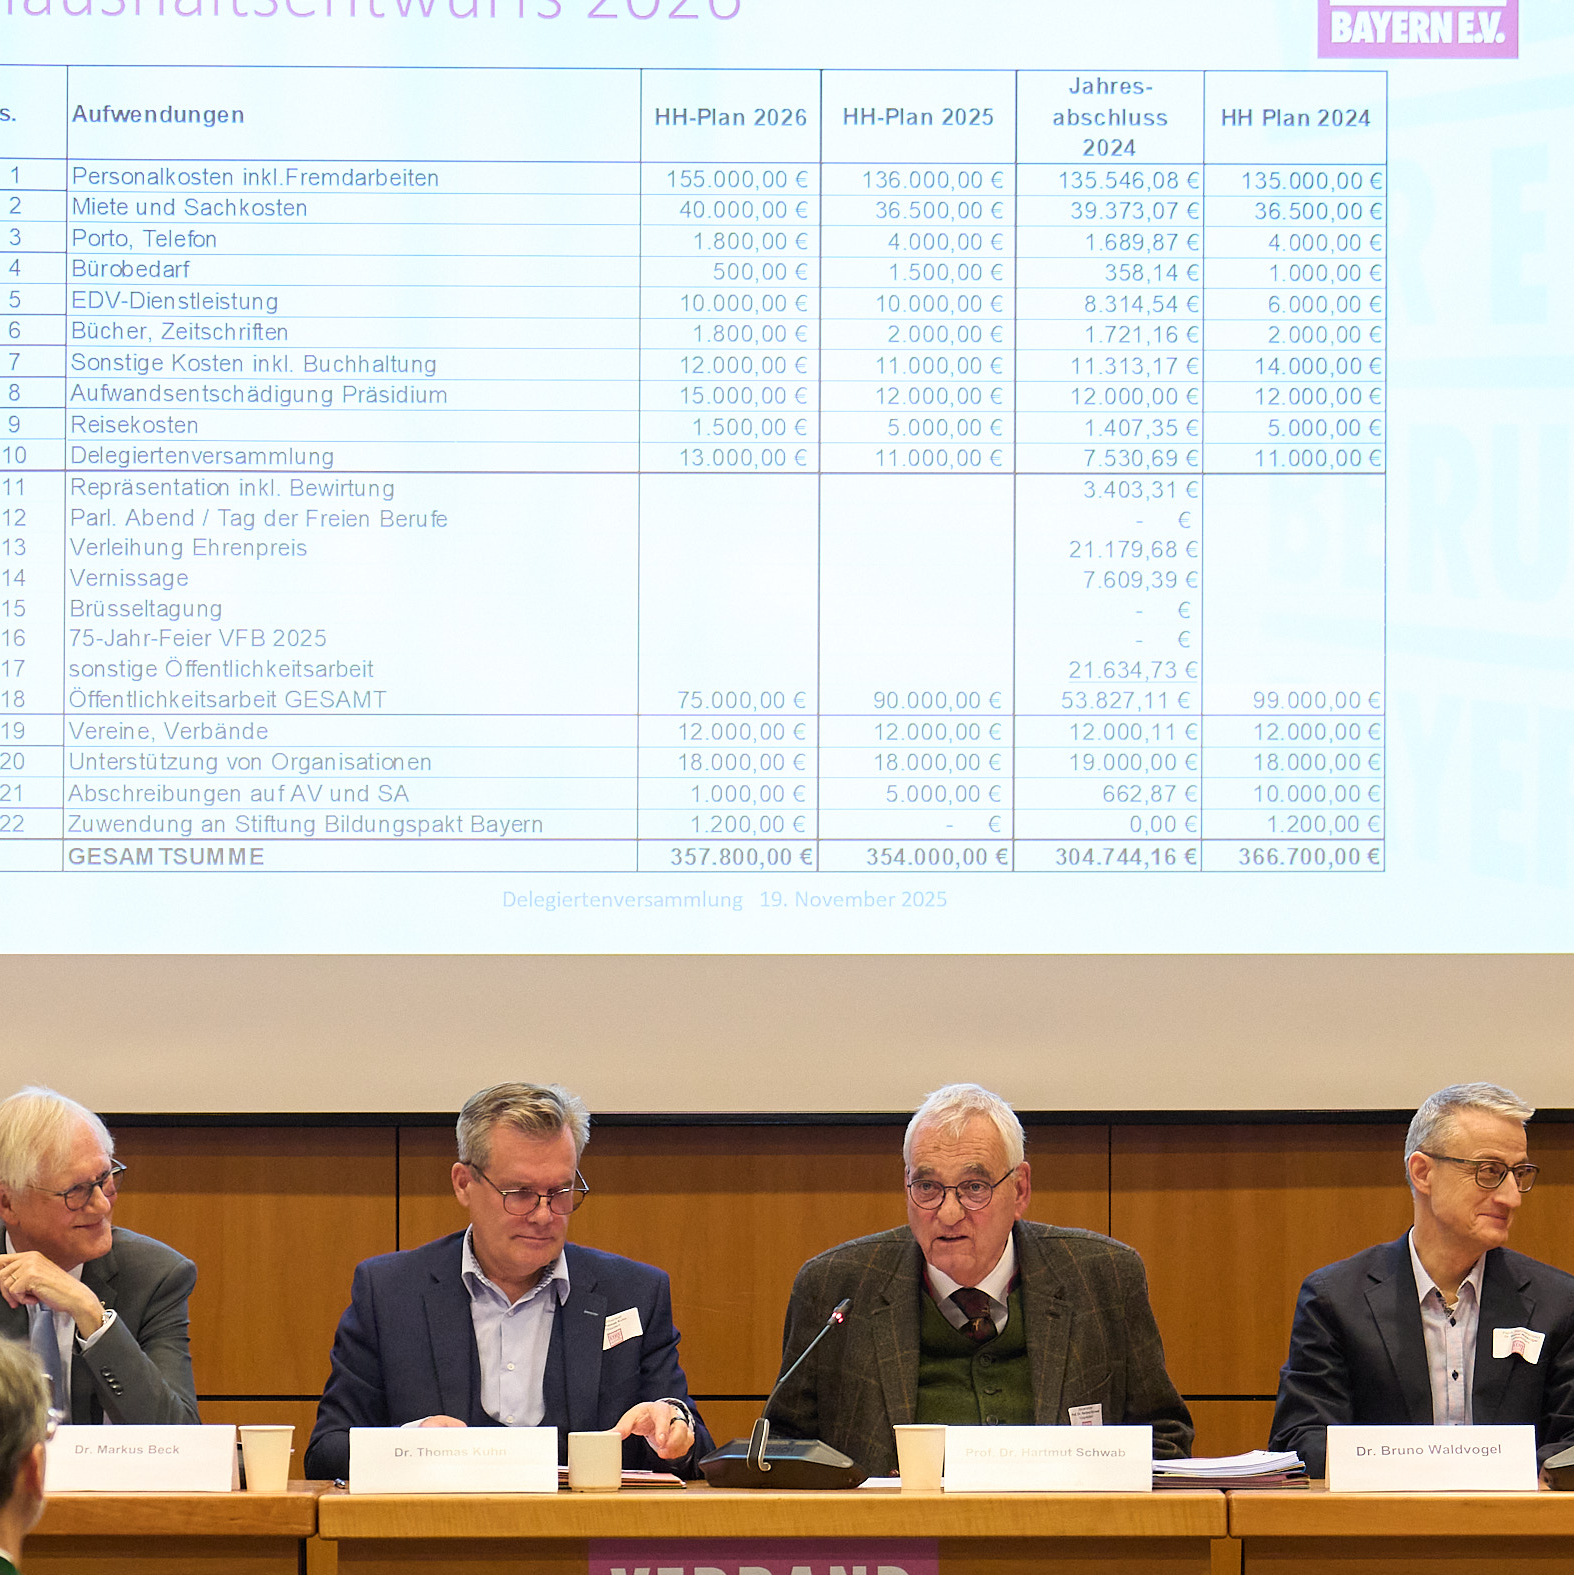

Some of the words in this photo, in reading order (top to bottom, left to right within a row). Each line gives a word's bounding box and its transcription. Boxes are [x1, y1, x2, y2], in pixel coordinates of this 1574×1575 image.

[1331, 11, 1453, 44] BAYERN
[1457, 11, 1506, 44] E.V.
[1068, 76, 1154, 96] Jahres-
[70, 104, 245, 129] Aufwendungen
[654, 107, 746, 127] HH-Plan
[753, 107, 808, 127] 2026
[842, 106, 934, 127] HH-Plan
[940, 107, 994, 127] 2025
[1052, 107, 1169, 127] abschluss
[1221, 108, 1254, 128] HH
[1261, 108, 1312, 128] Plan
[1316, 108, 1372, 128] 2024
[1081, 137, 1137, 158] 2024
[10, 165, 19, 185] 1
[72, 166, 234, 187] Personalkosten
[242, 167, 439, 188] inkl.Fremdarbeiten
[666, 169, 788, 192] 155.000,00
[794, 169, 809, 189] €
[862, 170, 983, 193] 136.000,00
[989, 170, 1005, 190] €
[1058, 170, 1179, 193] 135.546,08
[1185, 170, 1201, 190] €
[1241, 170, 1364, 194] 135.000,00
[1369, 171, 1384, 191] €
[8, 195, 22, 215] 2
[72, 196, 129, 217] Miete
[135, 197, 176, 217] und
[183, 197, 307, 217] Sachkosten
[8, 227, 22, 247] 3
[72, 227, 133, 252] Porto,
[141, 228, 217, 249] Telefon
[7, 258, 22, 278] 4
[71, 258, 192, 279] Bürobedarf
[8, 289, 21, 309] 5
[71, 290, 279, 315] EDV-Dienstleistung
[7, 320, 21, 340] 6
[71, 320, 152, 344] Bücher,
[160, 321, 288, 342] Zeitschriften
[8, 352, 21, 372] 7
[70, 352, 164, 376] Sonstige
[171, 353, 244, 373] Kosten
[252, 353, 294, 373] inkl.
[303, 354, 437, 378] Buchhaltung
[8, 382, 21, 402] 8
[68, 382, 333, 408] Aufwandsentschädigung
[342, 384, 448, 405] Präsidium
[7, 414, 21, 434] 9
[70, 414, 199, 435] Reisekosten
[2, 445, 27, 465] 10
[70, 445, 334, 470] Delegiertenversammlung
[2, 477, 24, 497] 11
[70, 477, 230, 501] Repräsentation
[238, 477, 281, 497] inkl.
[289, 478, 395, 502] Bewirtung
[1, 508, 27, 527] 12
[70, 507, 117, 527] Parl.
[124, 507, 195, 527] Abend
[201, 508, 210, 527] /
[216, 508, 256, 532] Tag
[263, 508, 300, 528] der
[305, 508, 370, 528] Freien
[380, 509, 448, 529] Berufe
[1, 537, 27, 557] 13
[68, 537, 183, 561] Verleihung
[192, 537, 308, 561] Ehrenpreis
[1068, 539, 1178, 562] 21.179,68
[1185, 540, 1199, 559] €
[1, 568, 26, 587] 14
[68, 568, 189, 592] Vernissage
[1, 599, 26, 618] 15
[70, 598, 222, 622] Brüsseltagung
[1, 628, 26, 648] 16
[68, 628, 213, 648] 75-Jahr-Feier
[217, 628, 266, 648] VFB
[272, 628, 327, 648] 2025
[1, 658, 26, 678] 17
[68, 659, 158, 682] sonstige
[165, 655, 375, 679] Öffentlichkeitsarbeit
[0, 689, 26, 709] 18
[68, 686, 278, 709] Öffentlichkeitsarbeit
[284, 689, 388, 709] GESAMT
[1253, 690, 1363, 713] 99.000,00
[1367, 690, 1382, 710] €
[0, 721, 26, 740] 19
[68, 721, 156, 744] Vereine,
[163, 721, 269, 741] Verbände
[69, 751, 218, 775] Unterstützung
[225, 756, 262, 771] von
[271, 752, 432, 775] Organisationen
[68, 783, 241, 807] Abschreibungen
[250, 783, 287, 803] auf
[289, 783, 324, 803] AV
[329, 783, 369, 803] und
[377, 783, 410, 803] SA
[68, 814, 193, 837] Zuwendung
[201, 818, 226, 833] an
[234, 814, 316, 837] Stiftung
[324, 814, 464, 837] Bildungspakt
[470, 814, 543, 837] Bayern
[68, 847, 265, 866] GESAMTSUMME
[670, 847, 792, 870] 357.800,00
[798, 847, 813, 866] €
[866, 847, 988, 870] 354.000,00
[994, 847, 1009, 866] €
[1055, 847, 1177, 870] 304.744,16
[1183, 847, 1198, 866] €
[1238, 847, 1361, 870] 366.700,00
[1366, 846, 1381, 866] €
[502, 890, 743, 912] Delegiertenversammlung
[760, 890, 788, 908] 19.
[794, 890, 895, 908] November
[901, 890, 947, 908] 2025
[74, 1444, 93, 1455] Dr.
[97, 1444, 144, 1455] Markus
[148, 1444, 180, 1455] Beck
[394, 1447, 413, 1458] Dr.
[416, 1447, 468, 1457] Thomas
[472, 1446, 507, 1457] Kuhn
[965, 1447, 995, 1458] Prof.
[999, 1447, 1018, 1458] Dr.
[1021, 1447, 1073, 1458] Hartmut
[1075, 1447, 1126, 1458] Schwab
[1356, 1446, 1376, 1457] Dr.
[1381, 1445, 1424, 1456] Bruno
[1428, 1444, 1502, 1457] Waldvogel
